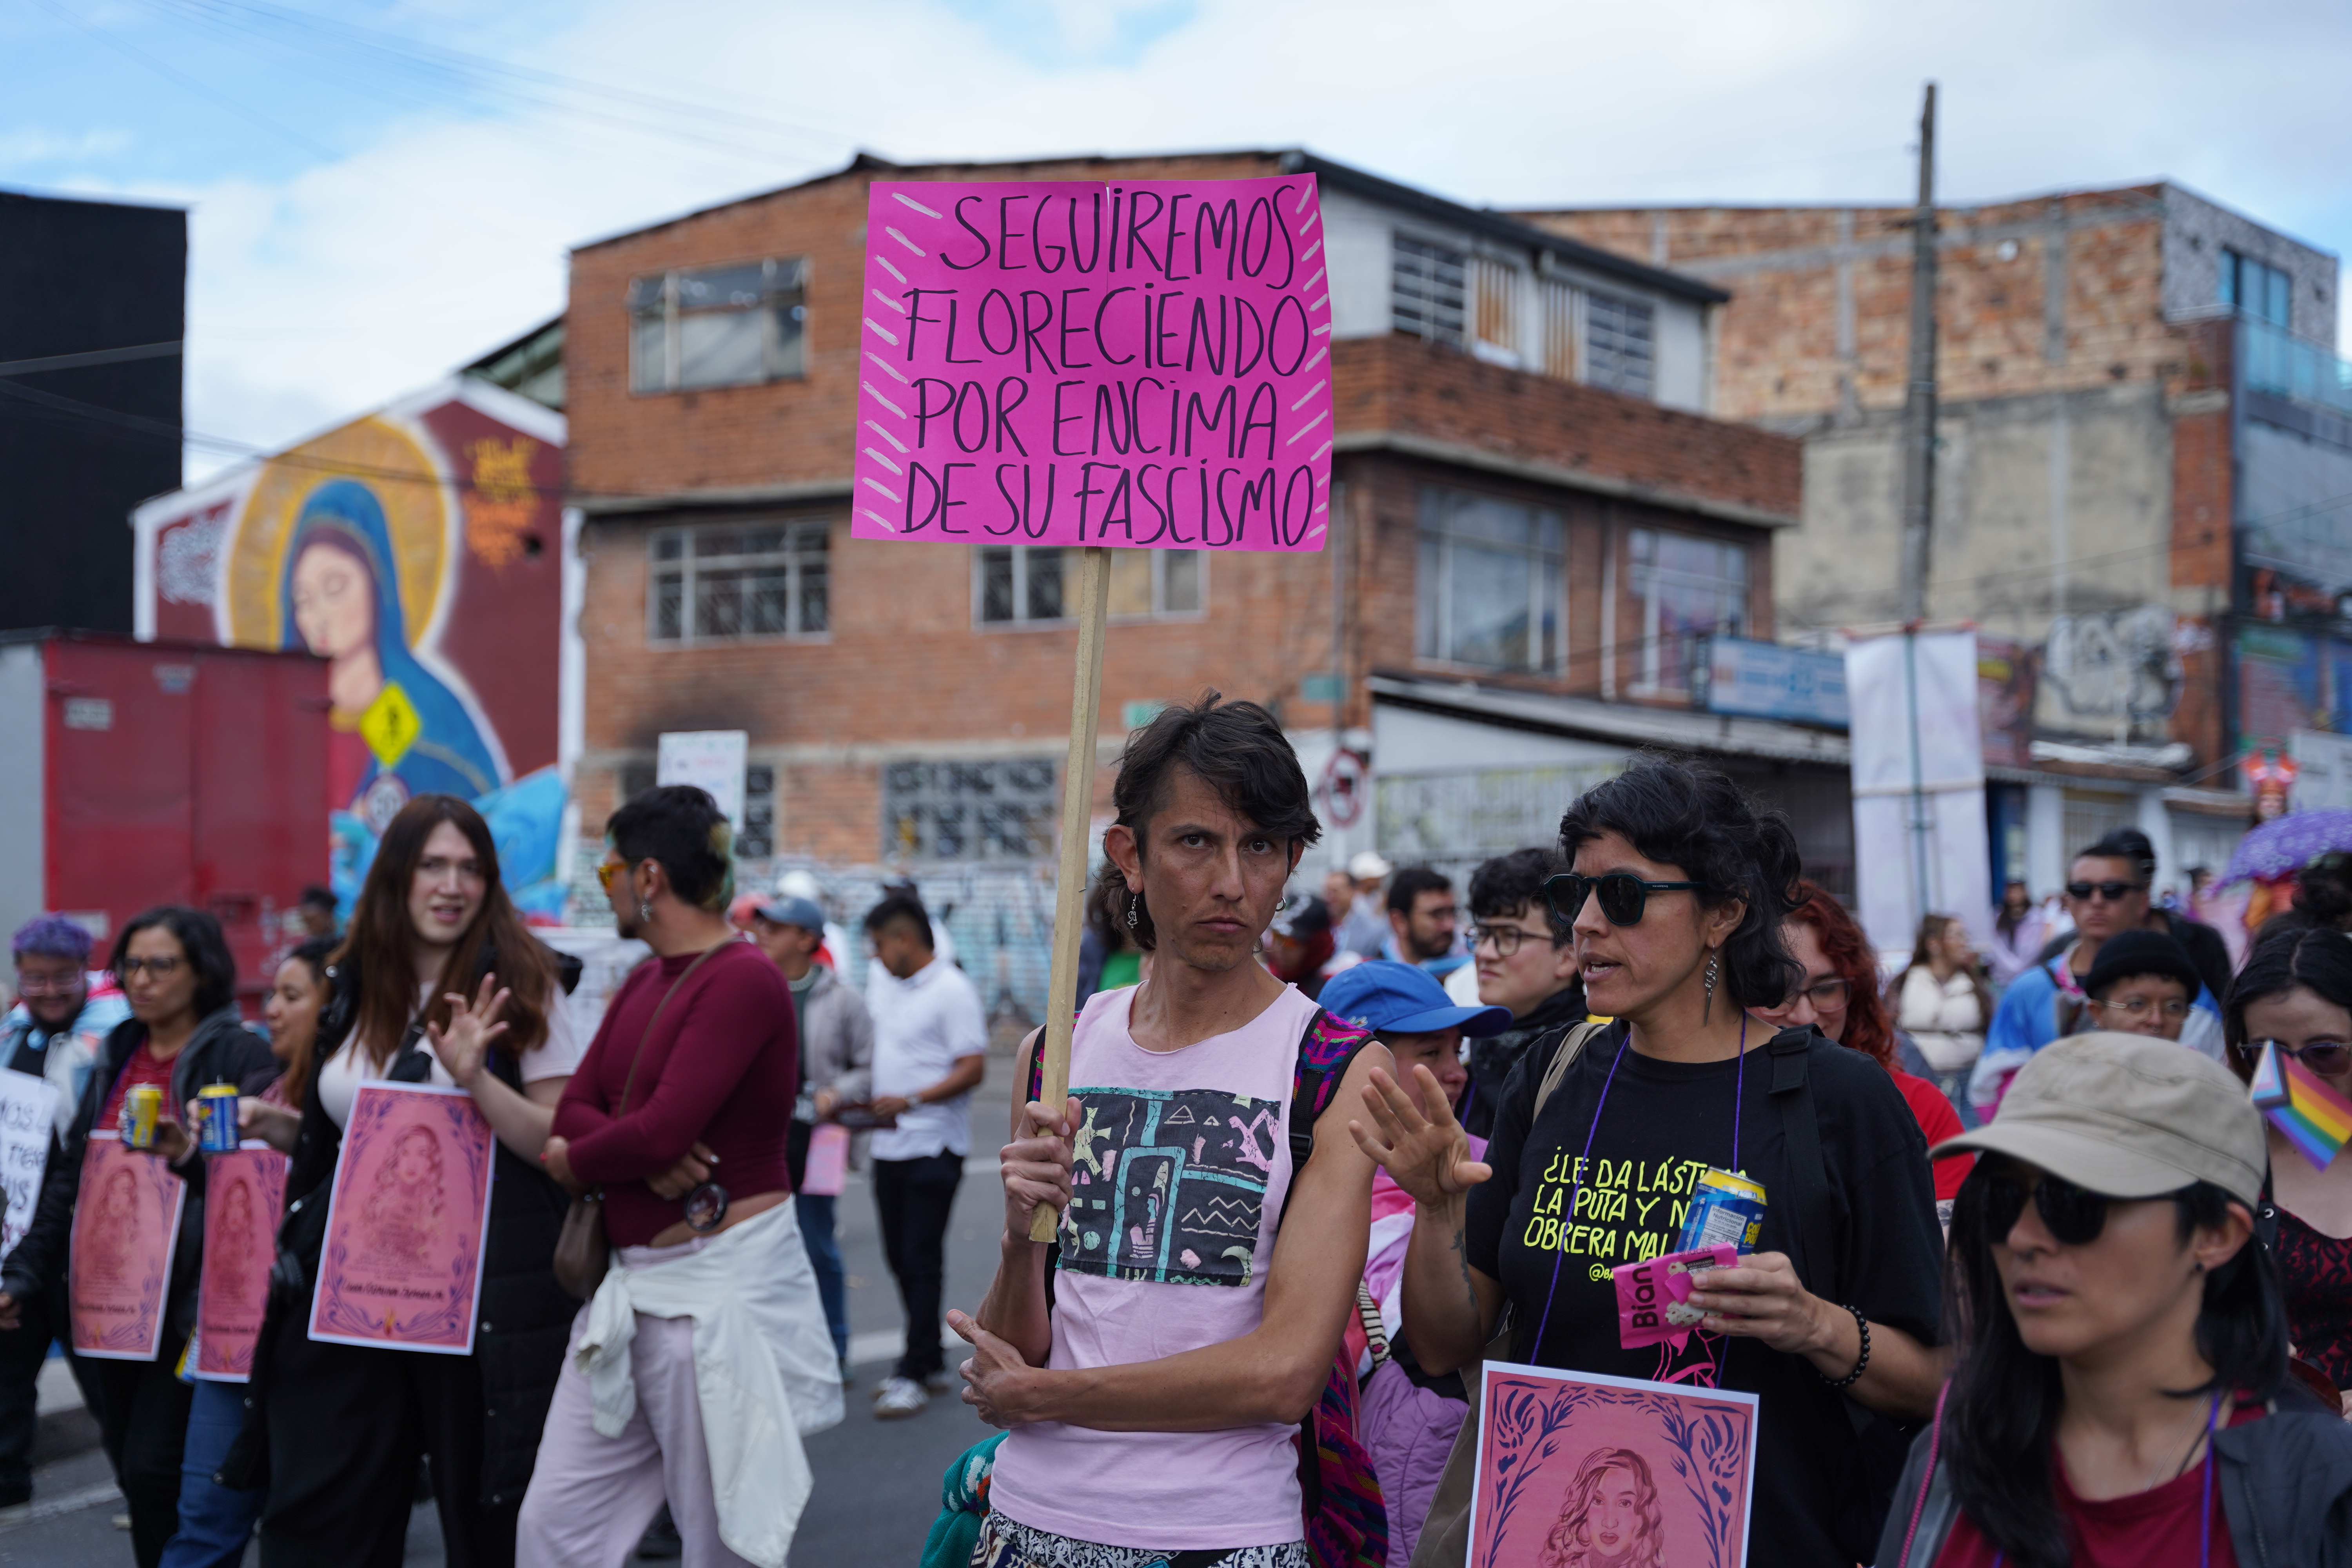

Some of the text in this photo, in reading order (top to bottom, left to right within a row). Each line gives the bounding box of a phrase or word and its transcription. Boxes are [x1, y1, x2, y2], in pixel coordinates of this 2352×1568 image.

[939, 185, 1295, 289] SEGUIREMOS
[902, 282, 1309, 378] FLORECIENDO
[911, 376, 1276, 460] POR ENCIMA
[900, 459, 1313, 546] DE SU FASCISMO
[1544, 1146, 1746, 1195] ¿LE DA LÁST
[1533, 1184, 1563, 1216] LA
[1573, 1187, 1627, 1222] PUTA
[1635, 1196, 1661, 1226] Y
[1712, 1207, 1744, 1222] Información
[1713, 1213, 1742, 1227] Nutricional
[1524, 1216, 1616, 1259] OBRERA
[1631, 1266, 1659, 1328] Bian
